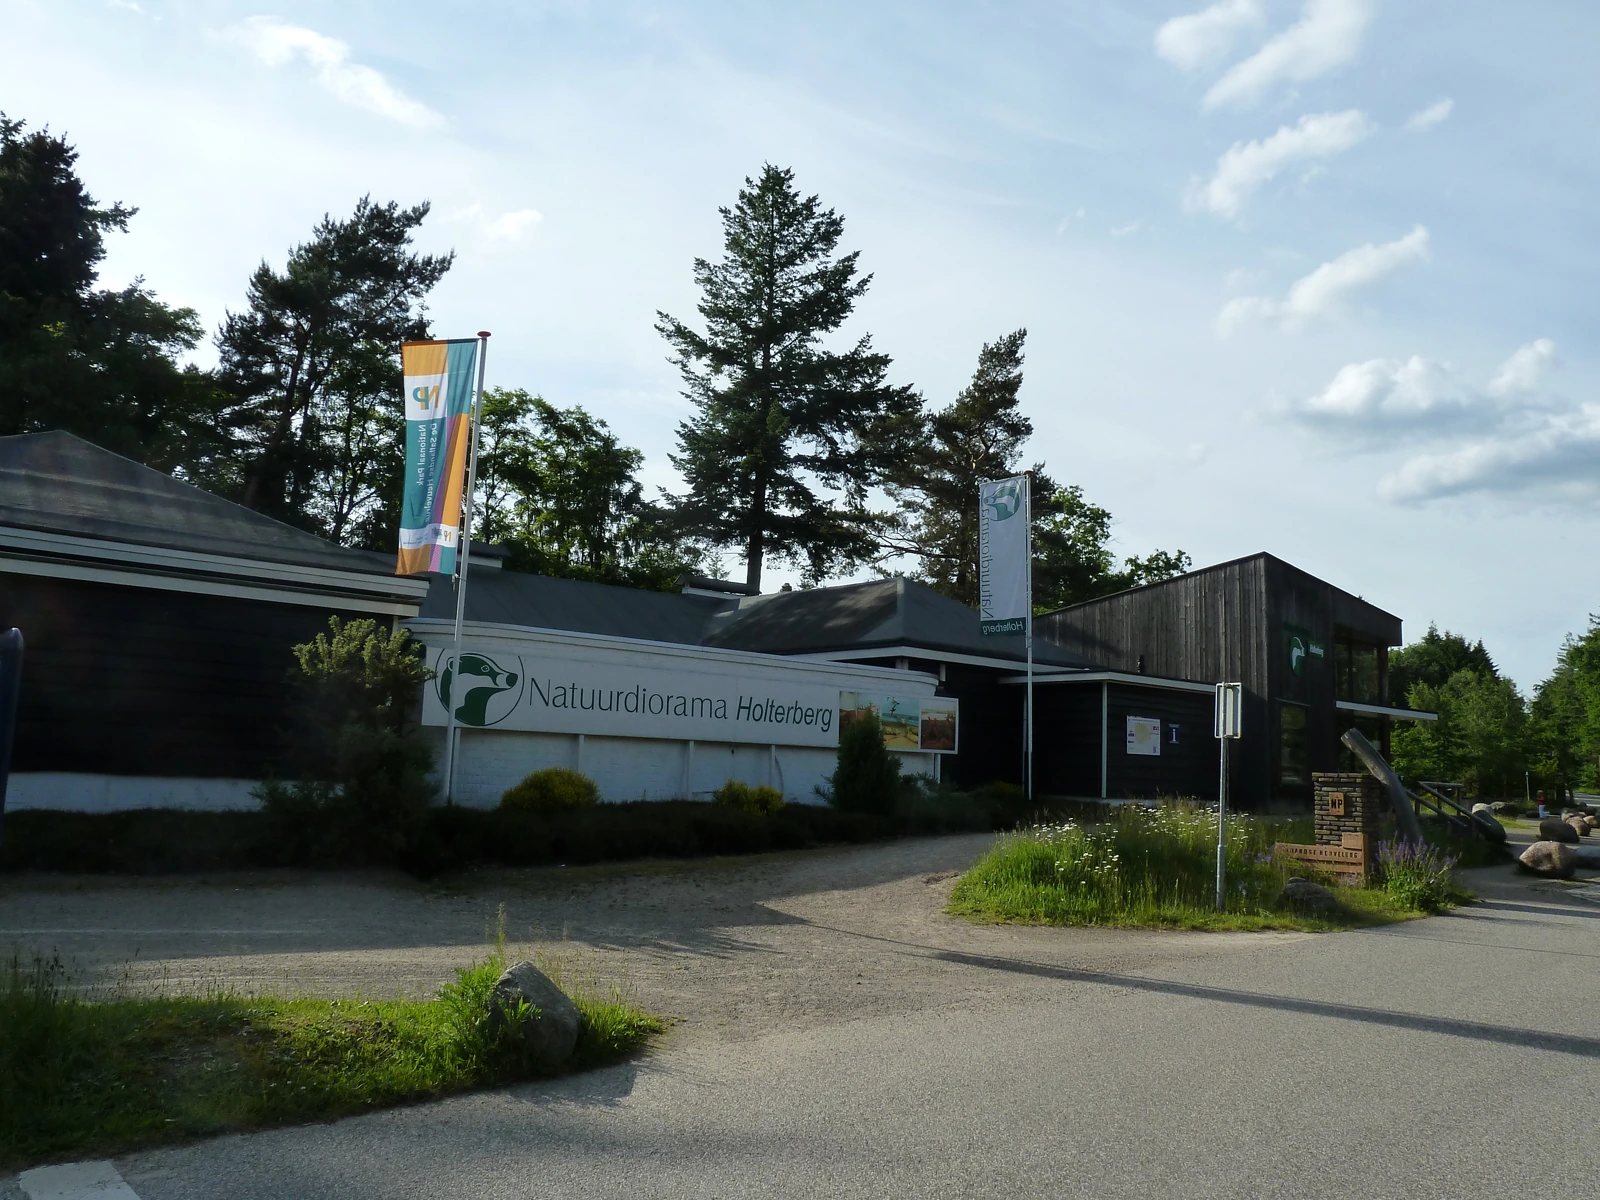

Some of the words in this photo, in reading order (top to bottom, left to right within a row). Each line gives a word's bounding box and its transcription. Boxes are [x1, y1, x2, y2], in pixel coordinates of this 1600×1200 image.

[529, 677, 728, 720] Natuurdiorama
[736, 695, 834, 733] Holterberg
[1331, 799, 1342, 809] NP
